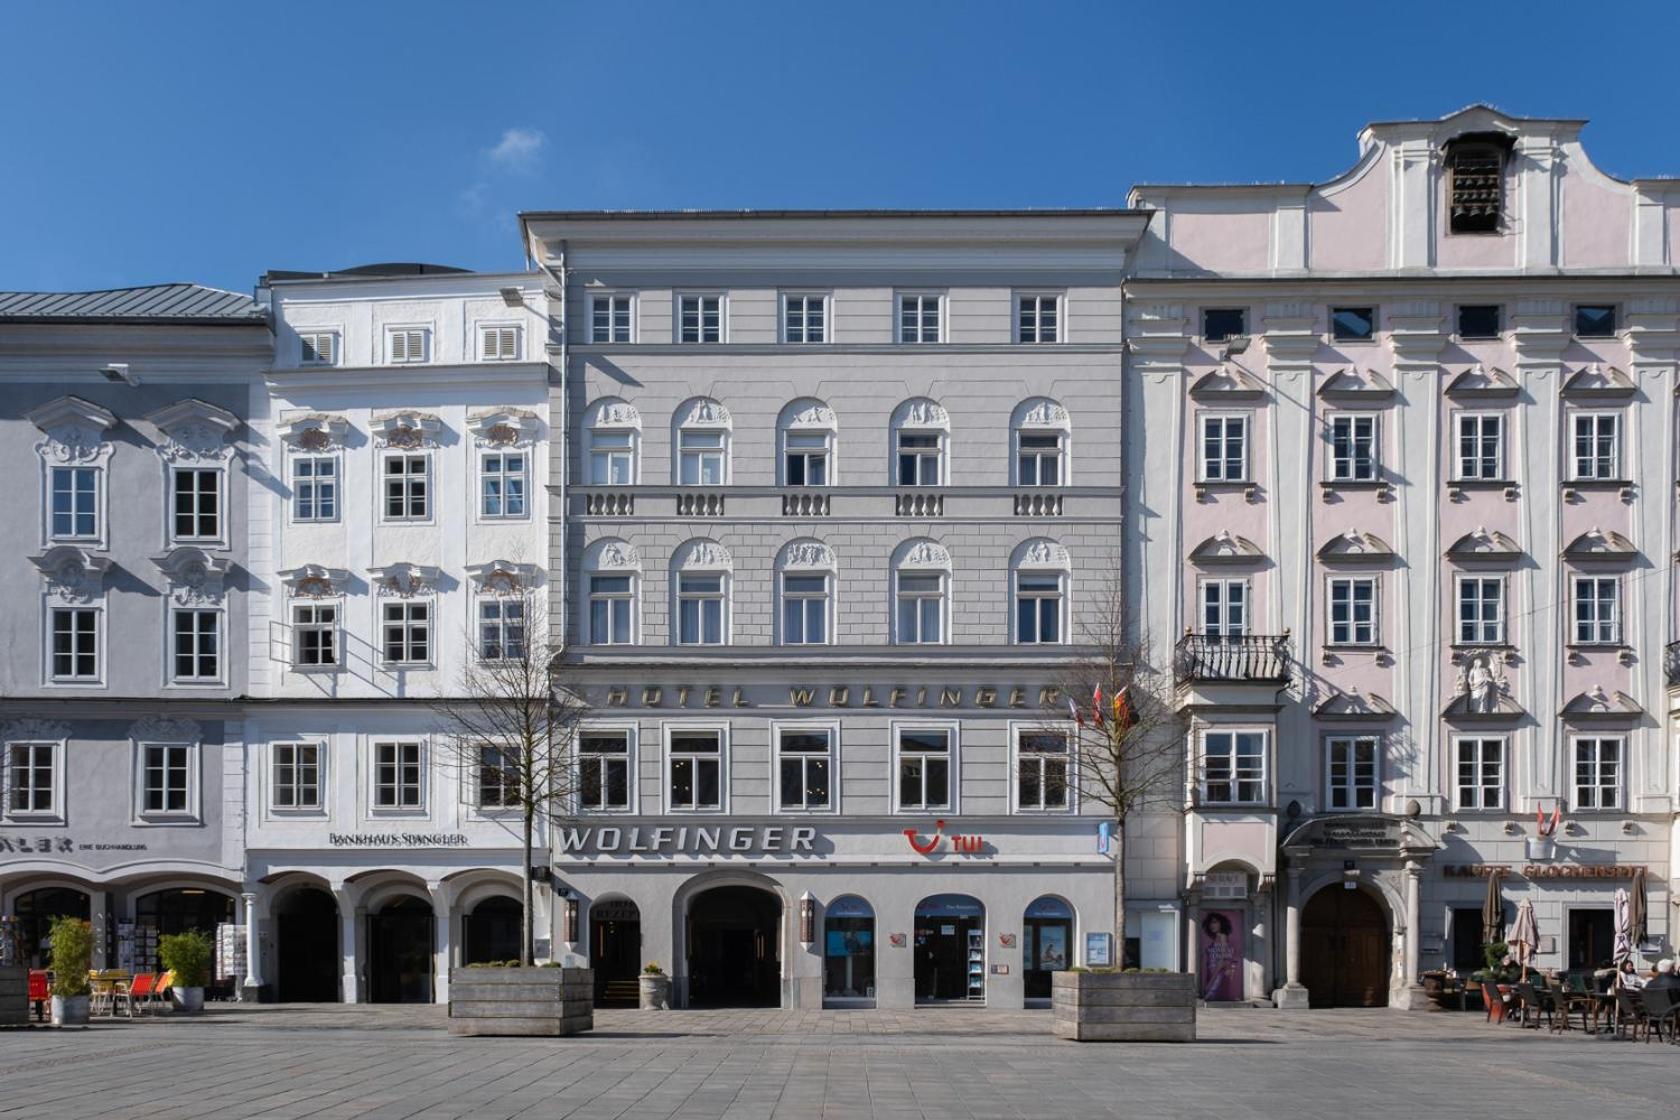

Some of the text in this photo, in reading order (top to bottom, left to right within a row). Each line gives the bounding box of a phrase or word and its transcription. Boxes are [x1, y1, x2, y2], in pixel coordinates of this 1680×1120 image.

[607, 686, 1060, 707] HOTEL WOLFINGER
[329, 832, 468, 847] BANKHAUS SPANGLER
[558, 827, 817, 851] WOLFINGER
[951, 836, 982, 852] TUI
